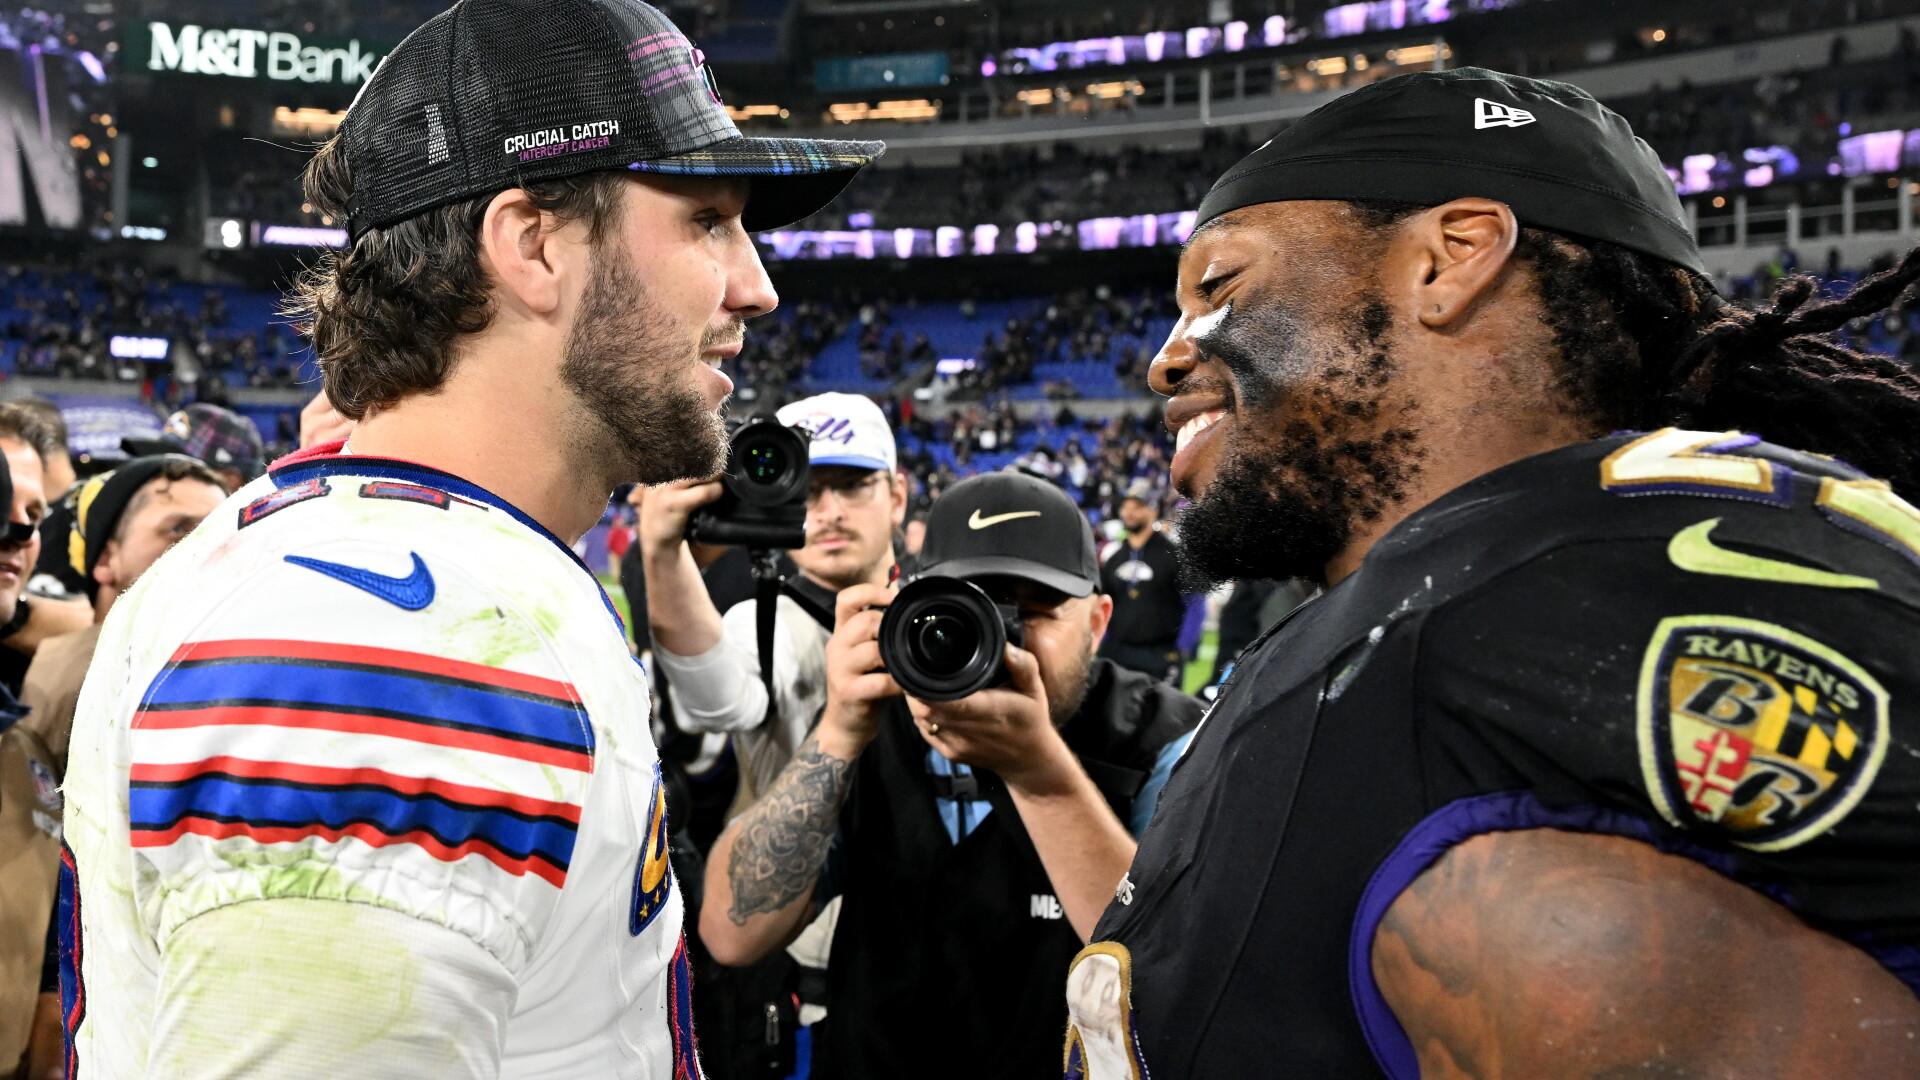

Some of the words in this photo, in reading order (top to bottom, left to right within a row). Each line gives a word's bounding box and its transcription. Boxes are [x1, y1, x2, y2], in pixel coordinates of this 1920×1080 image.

[148, 22, 268, 78] M&T
[267, 32, 375, 85] Bank
[504, 128, 570, 154] CRUCIAL
[572, 120, 619, 140] CATCH
[519, 142, 570, 160] INTERCEPT
[571, 136, 610, 152] CANCER
[1679, 663, 1778, 729] B
[1684, 634, 1860, 710] RAVENS
